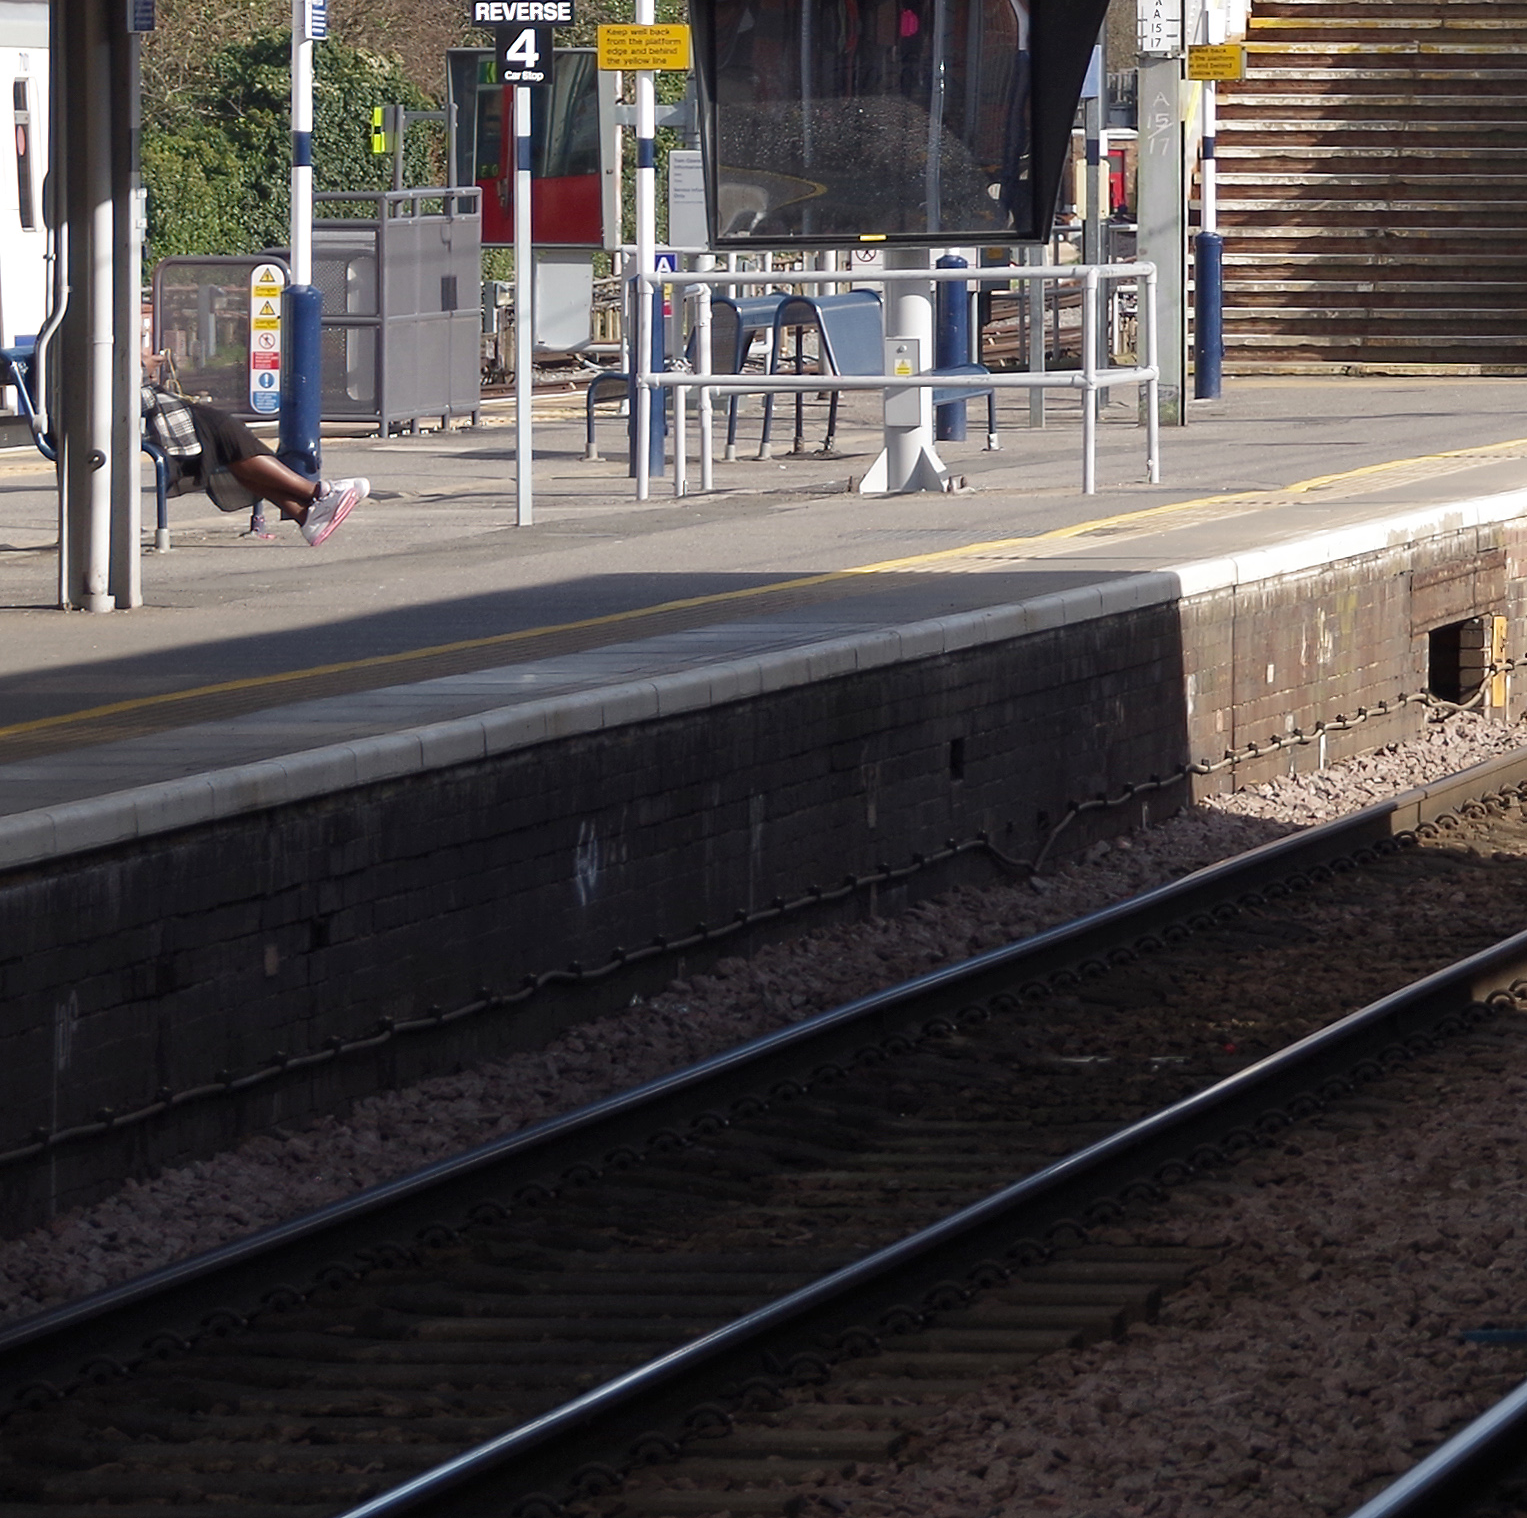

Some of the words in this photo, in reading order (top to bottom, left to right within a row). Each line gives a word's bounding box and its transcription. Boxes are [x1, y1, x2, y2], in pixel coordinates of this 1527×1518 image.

[475, 1, 572, 22] REVERSE
[1151, 23, 1162, 33] 15
[645, 38, 681, 46] platform
[1150, 38, 1162, 48] 17
[506, 28, 540, 69] 4
[623, 57, 650, 65] yellow
